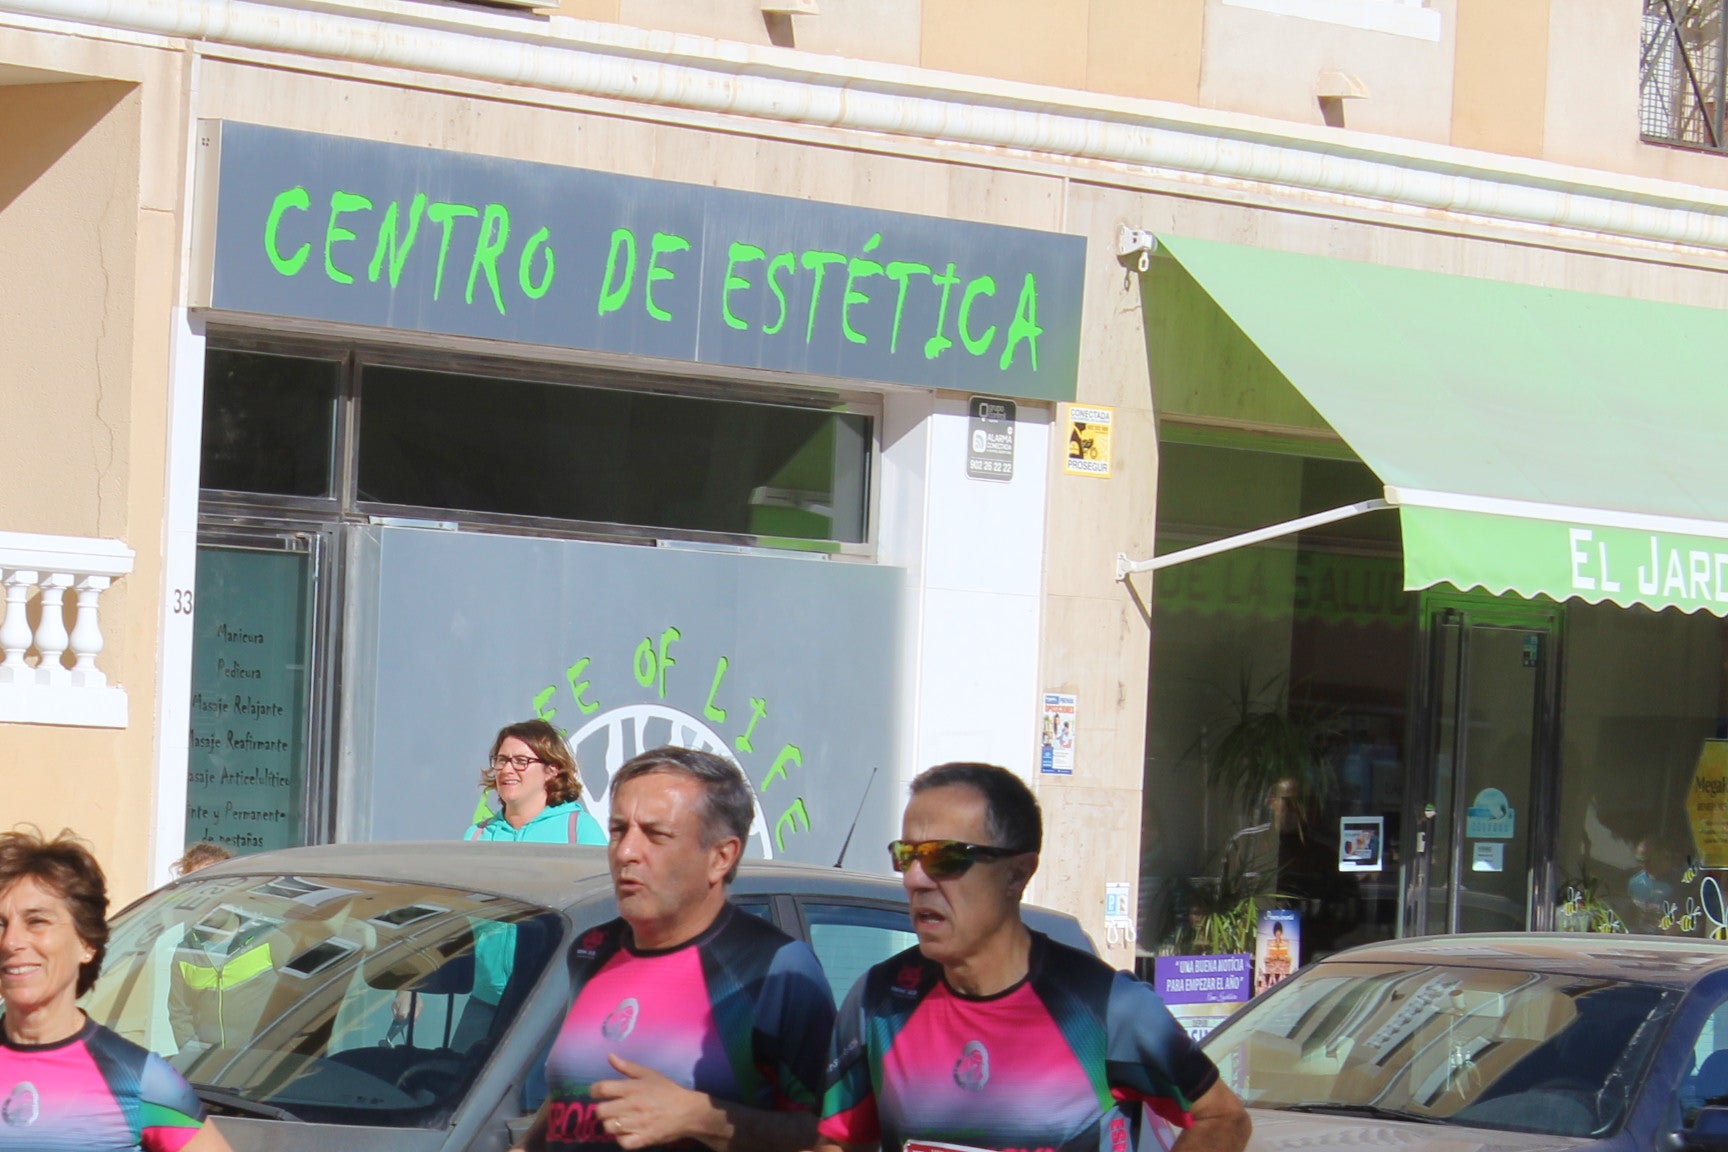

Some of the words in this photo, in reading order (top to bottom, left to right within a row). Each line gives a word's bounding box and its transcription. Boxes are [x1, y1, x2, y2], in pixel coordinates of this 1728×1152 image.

[264, 185, 555, 317] CENTRO
[598, 228, 689, 321] DE
[721, 232, 1043, 371] ESTÉTICA
[1071, 408, 1110, 420] CONECTADA
[987, 433, 1012, 444] ALARMA
[1068, 460, 1108, 472] PROSEGUR
[173, 589, 193, 615] 33
[217, 624, 264, 643] Manicura
[217, 658, 261, 679] Pedicura
[633, 626, 681, 699] OF
[234, 695, 283, 720] Relajante
[227, 730, 288, 752] Reafirmante
[703, 655, 811, 852] LIFE
[1195, 959, 1218, 973] BUENA
[1166, 978, 1184, 992] PARA
[1185, 977, 1217, 992] EMPEZAR
[1217, 977, 1224, 990] EL
